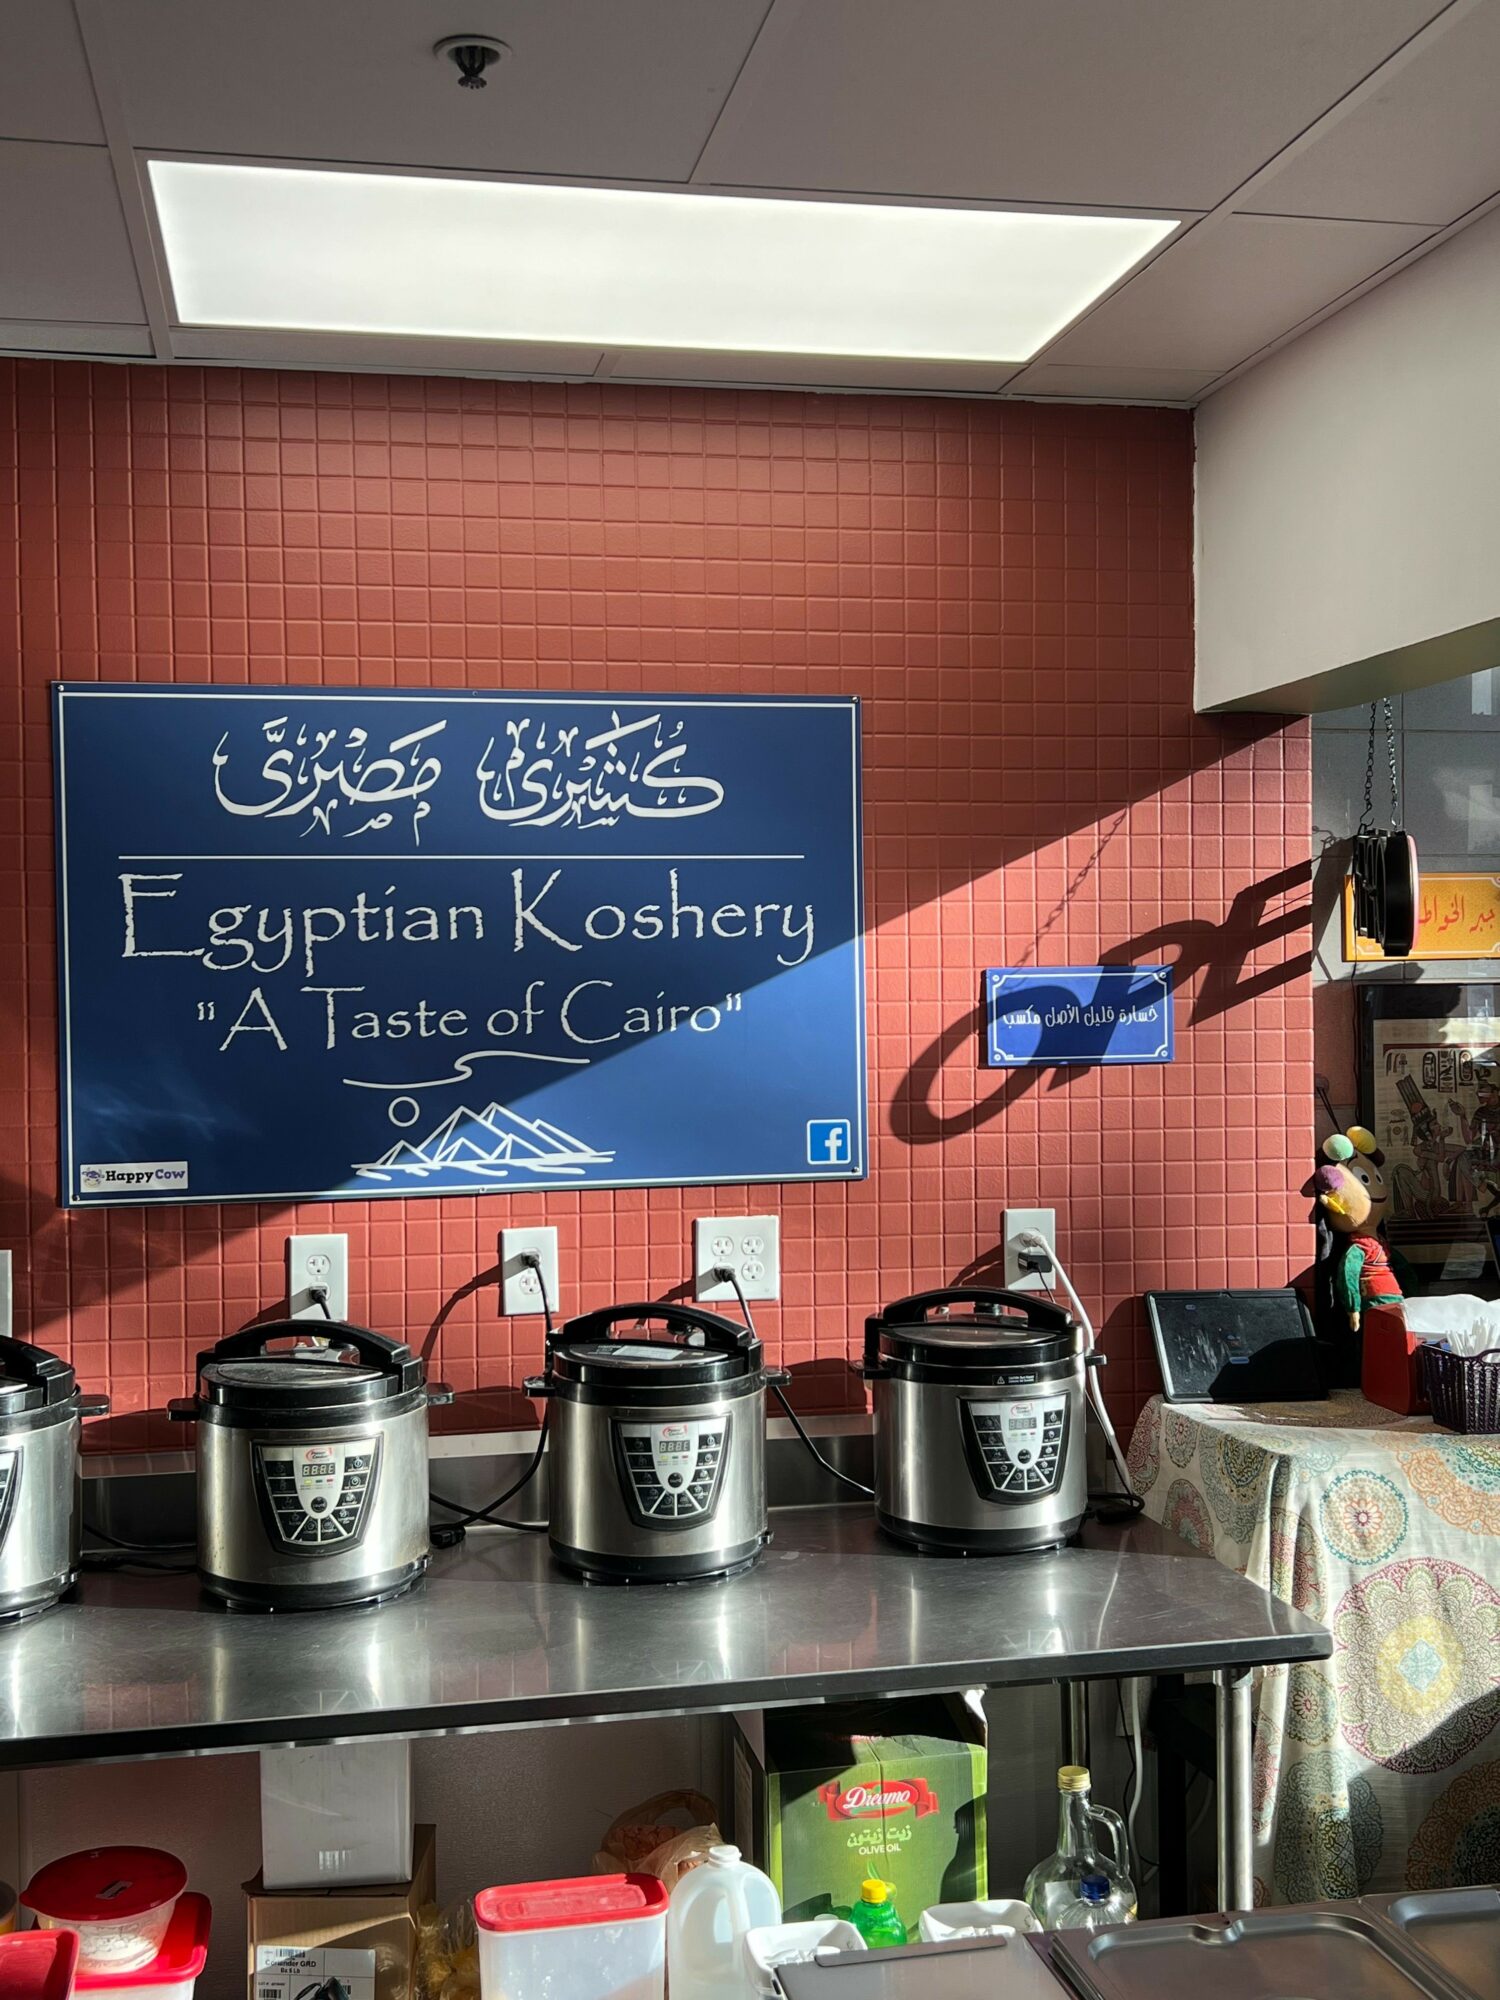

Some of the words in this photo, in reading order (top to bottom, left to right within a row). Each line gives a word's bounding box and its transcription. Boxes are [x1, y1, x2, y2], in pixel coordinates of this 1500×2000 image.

[118, 873, 484, 977] Egyptian
[512, 868, 814, 966] Koshery
[197, 987, 288, 1051] "A
[301, 986, 468, 1050] Taste
[487, 980, 545, 1036] of
[561, 980, 742, 1044] Cairo"
[1003, 1004, 1041, 1028] مكسب
[1084, 1006, 1115, 1027] قليل
[842, 1786, 911, 1809] Dreamo
[847, 1827, 884, 1847] زيتون
[887, 1825, 912, 1841] زيت
[859, 1846, 885, 1855] OLIVE
[886, 1843, 902, 1852] OIL
